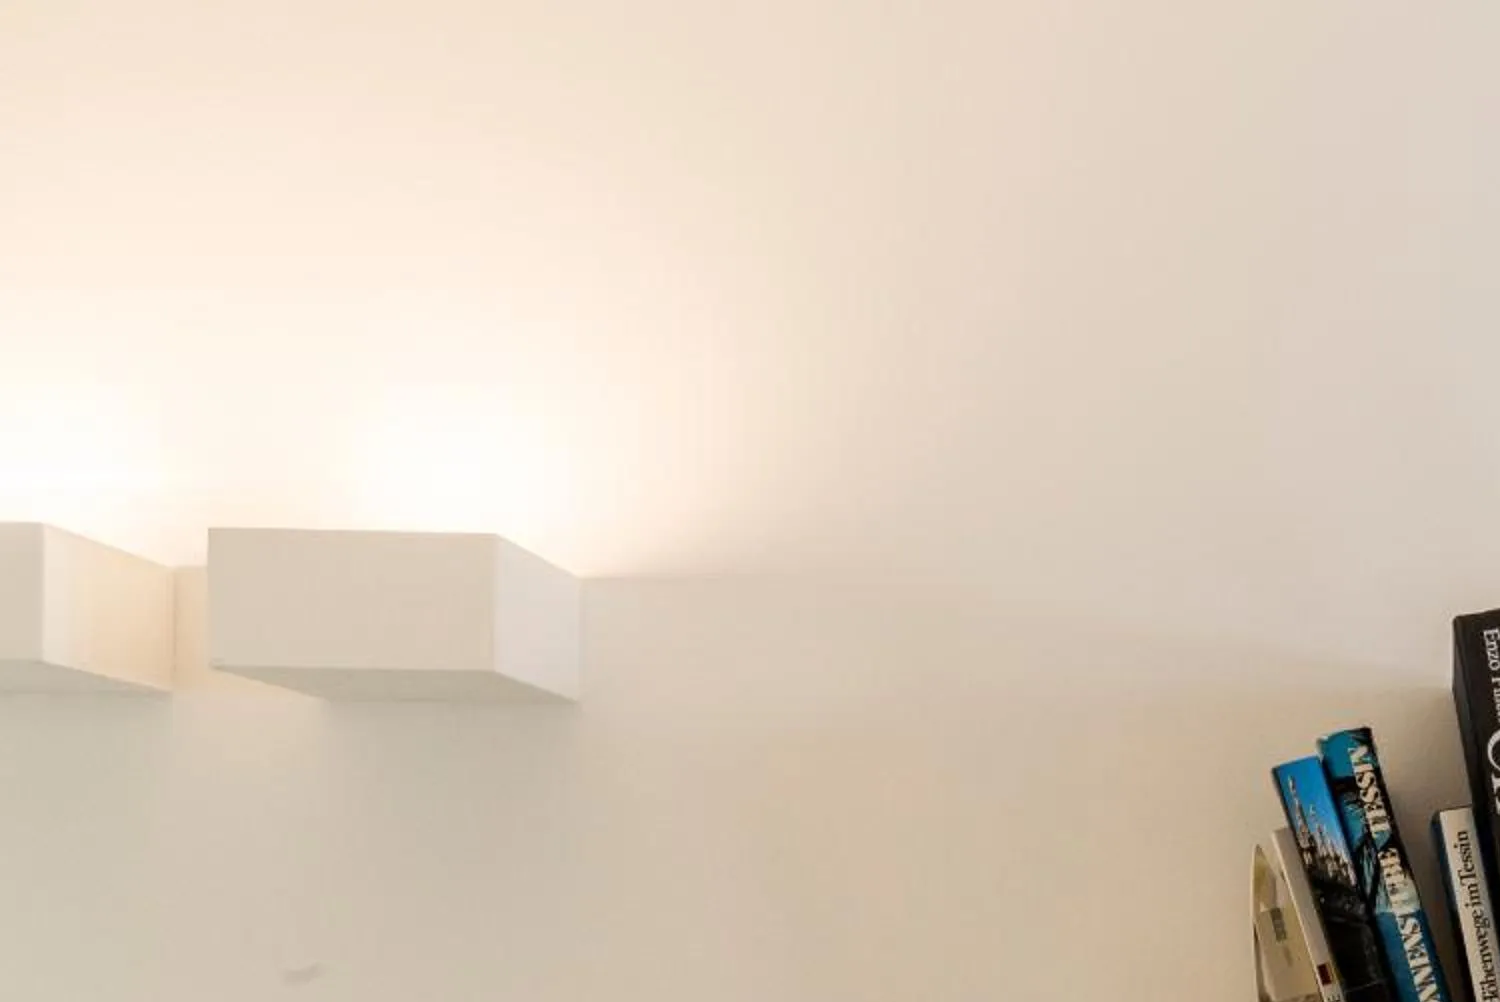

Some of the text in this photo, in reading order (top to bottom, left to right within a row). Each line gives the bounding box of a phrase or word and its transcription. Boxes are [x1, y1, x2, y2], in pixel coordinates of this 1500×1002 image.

[1484, 628, 1500, 671] Enzo
[1348, 745, 1392, 842] TESSIN
[1453, 831, 1476, 885] Tessin
[1465, 884, 1482, 908] im
